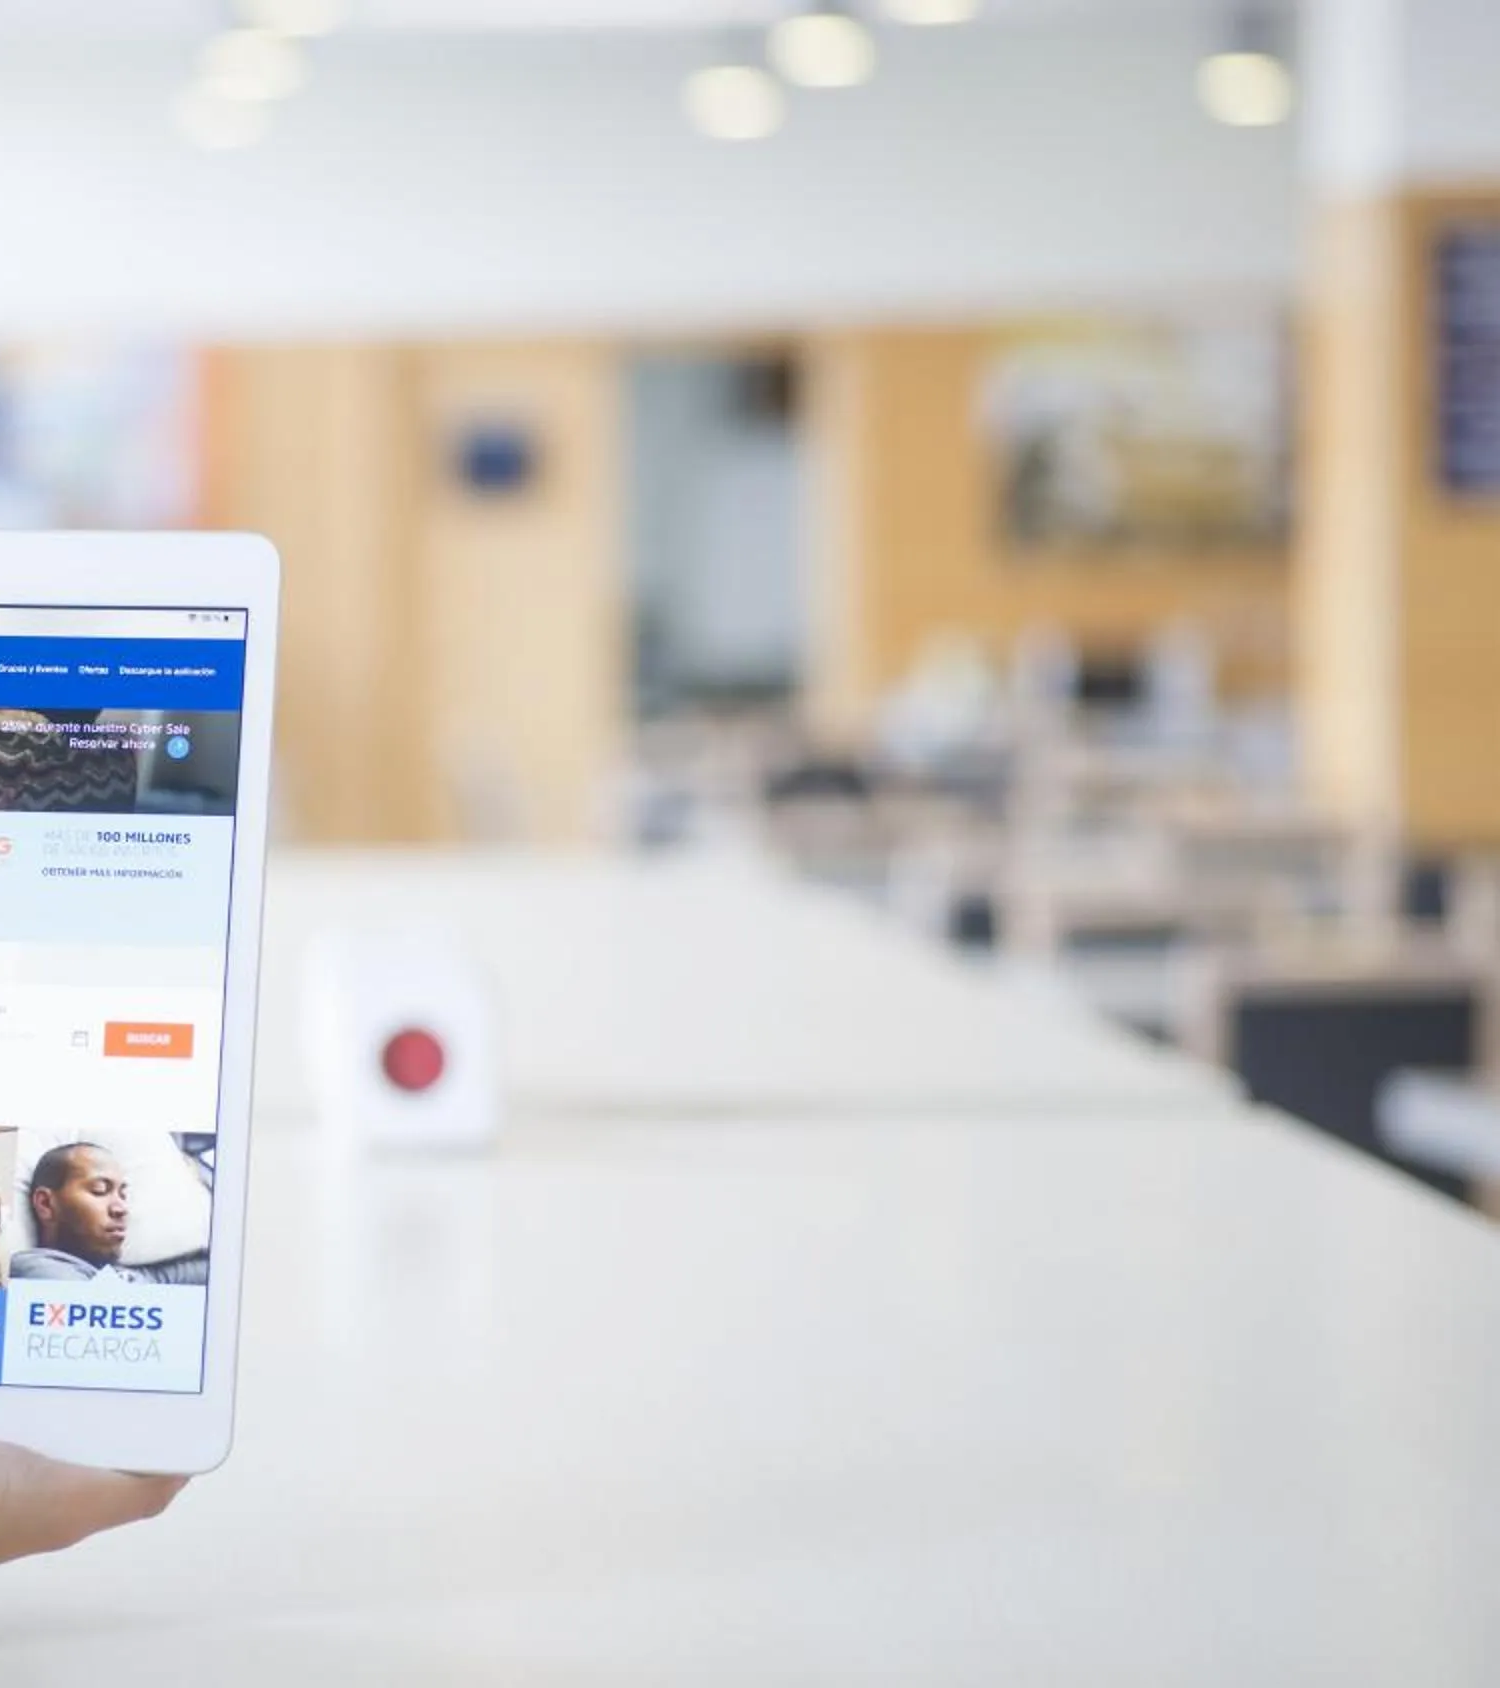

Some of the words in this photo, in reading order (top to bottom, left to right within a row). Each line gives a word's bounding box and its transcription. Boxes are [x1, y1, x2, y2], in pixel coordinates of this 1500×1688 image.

[35, 721, 81, 733] durante
[83, 723, 127, 734] nuestro
[129, 722, 163, 736] Cyber
[166, 723, 191, 736] Sale
[69, 737, 118, 749] Reservar
[121, 738, 156, 750] ahora
[97, 831, 121, 843] 100
[125, 831, 192, 845] MILLONES
[41, 866, 87, 877] OBTENER
[29, 1302, 164, 1331] EXPRESS
[26, 1333, 162, 1363] RECARGA
